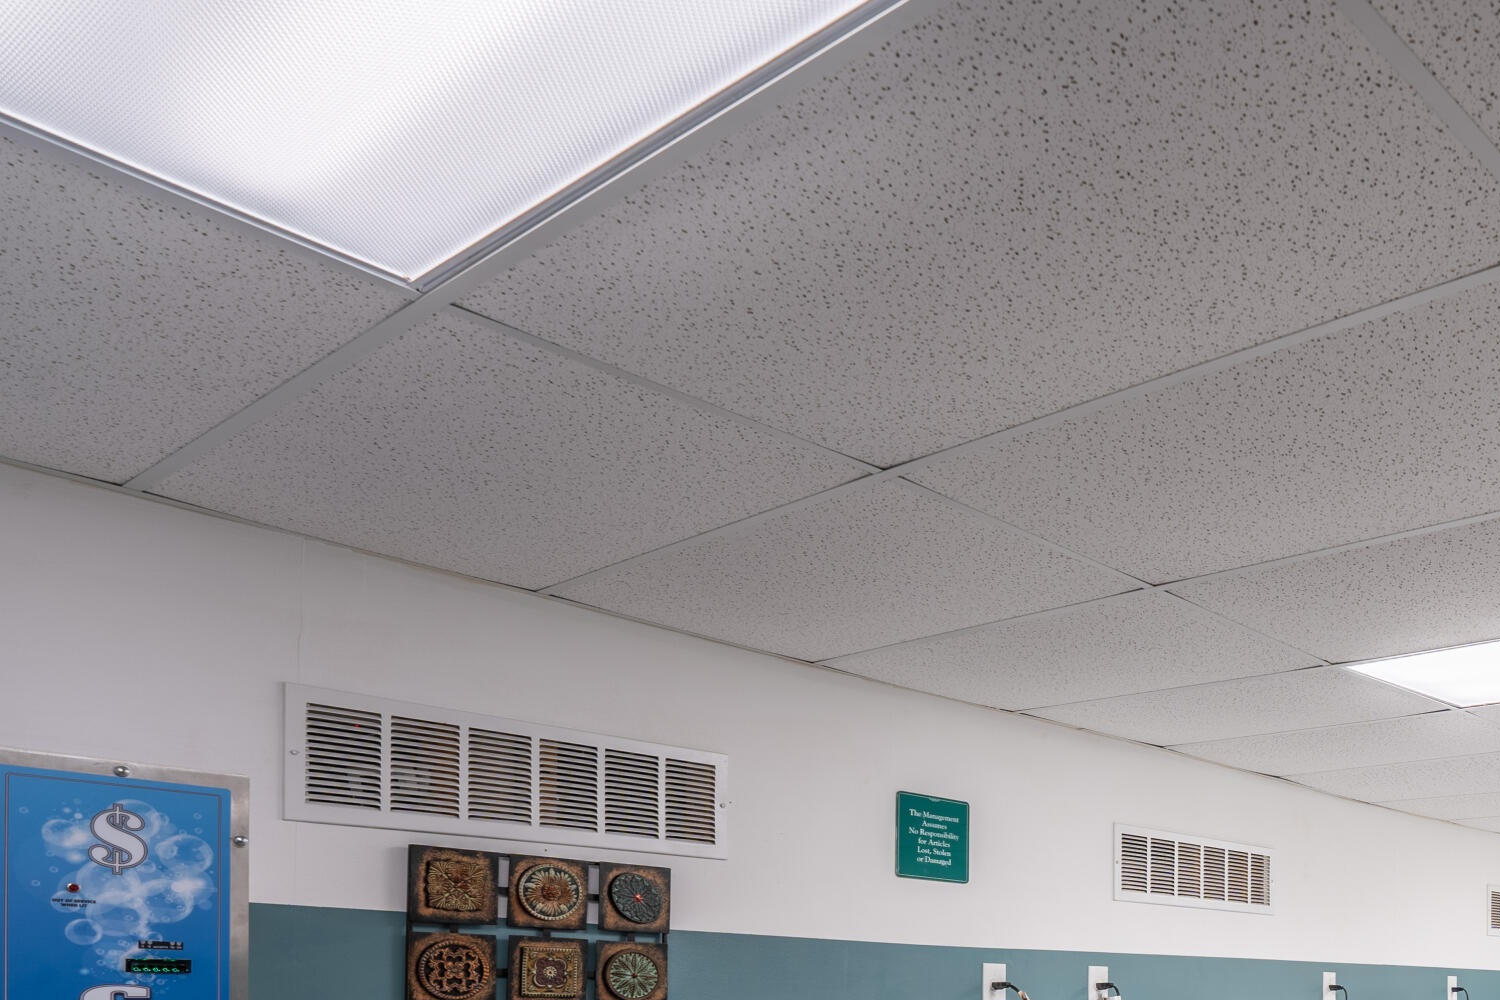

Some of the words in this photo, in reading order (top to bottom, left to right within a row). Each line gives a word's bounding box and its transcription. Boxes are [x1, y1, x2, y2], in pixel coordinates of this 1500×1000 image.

[909, 808, 921, 817] The
[923, 811, 959, 823] Management
[922, 820, 948, 830] Assumes
[909, 827, 919, 835] No
[920, 828, 959, 841] Responsibility
[918, 837, 927, 845] for
[928, 838, 951, 848] Articles
[917, 846, 932, 855] Lost,
[933, 848, 951, 857] Stolen
